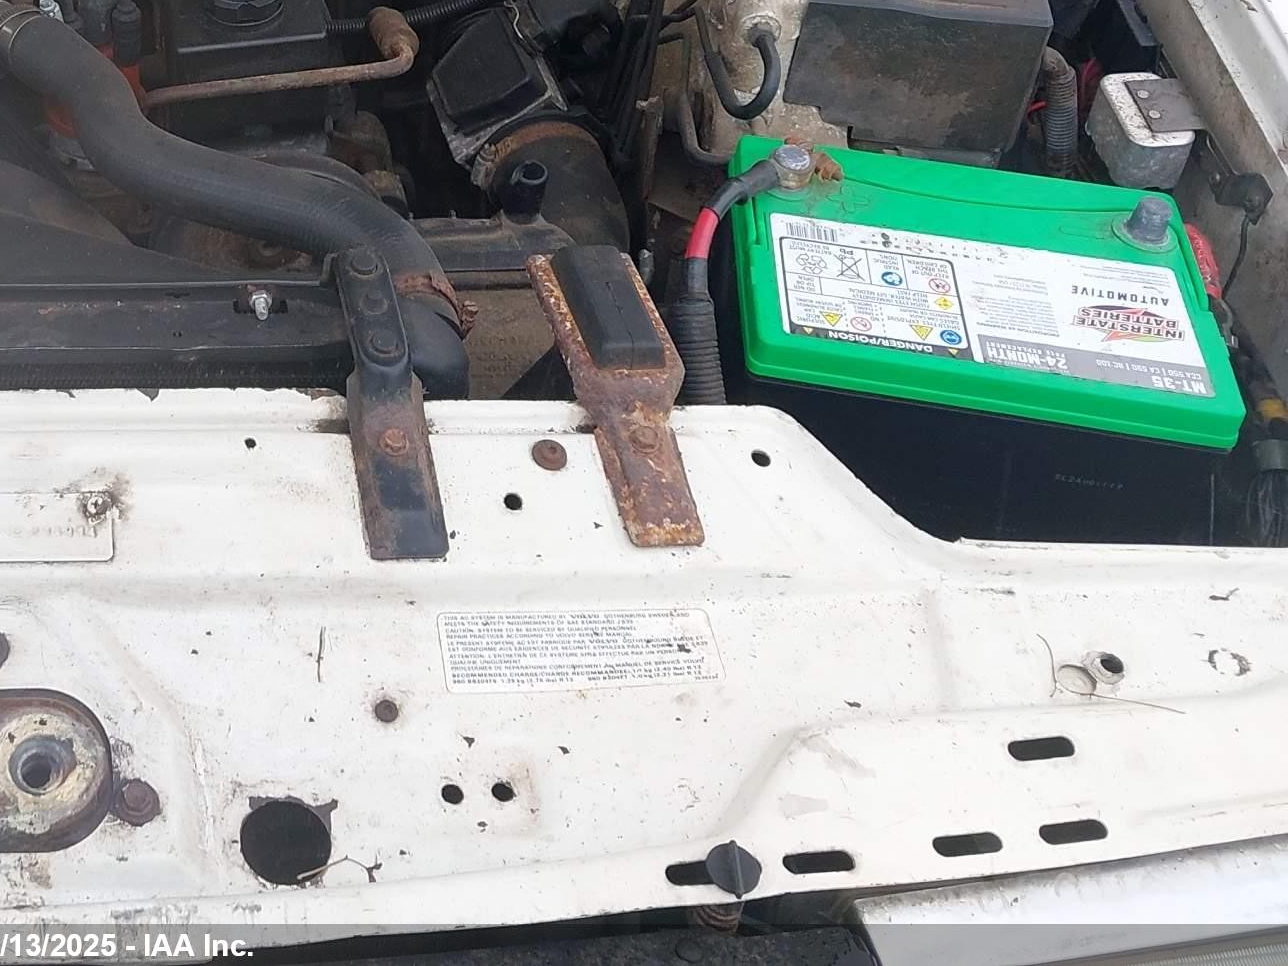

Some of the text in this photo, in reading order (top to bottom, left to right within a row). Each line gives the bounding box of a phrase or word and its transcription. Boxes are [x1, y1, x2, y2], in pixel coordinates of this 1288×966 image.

[1069, 284, 1171, 306] AUTOMOTIVE
[1073, 315, 1184, 339] INTERSTATE
[1079, 307, 1178, 329] BATTERIES
[828, 330, 931, 352] DANGER/POISON
[985, 346, 1067, 368] 24-MONTH
[1149, 374, 1206, 393] MT-35
[1184, 371, 1201, 379] CCA
